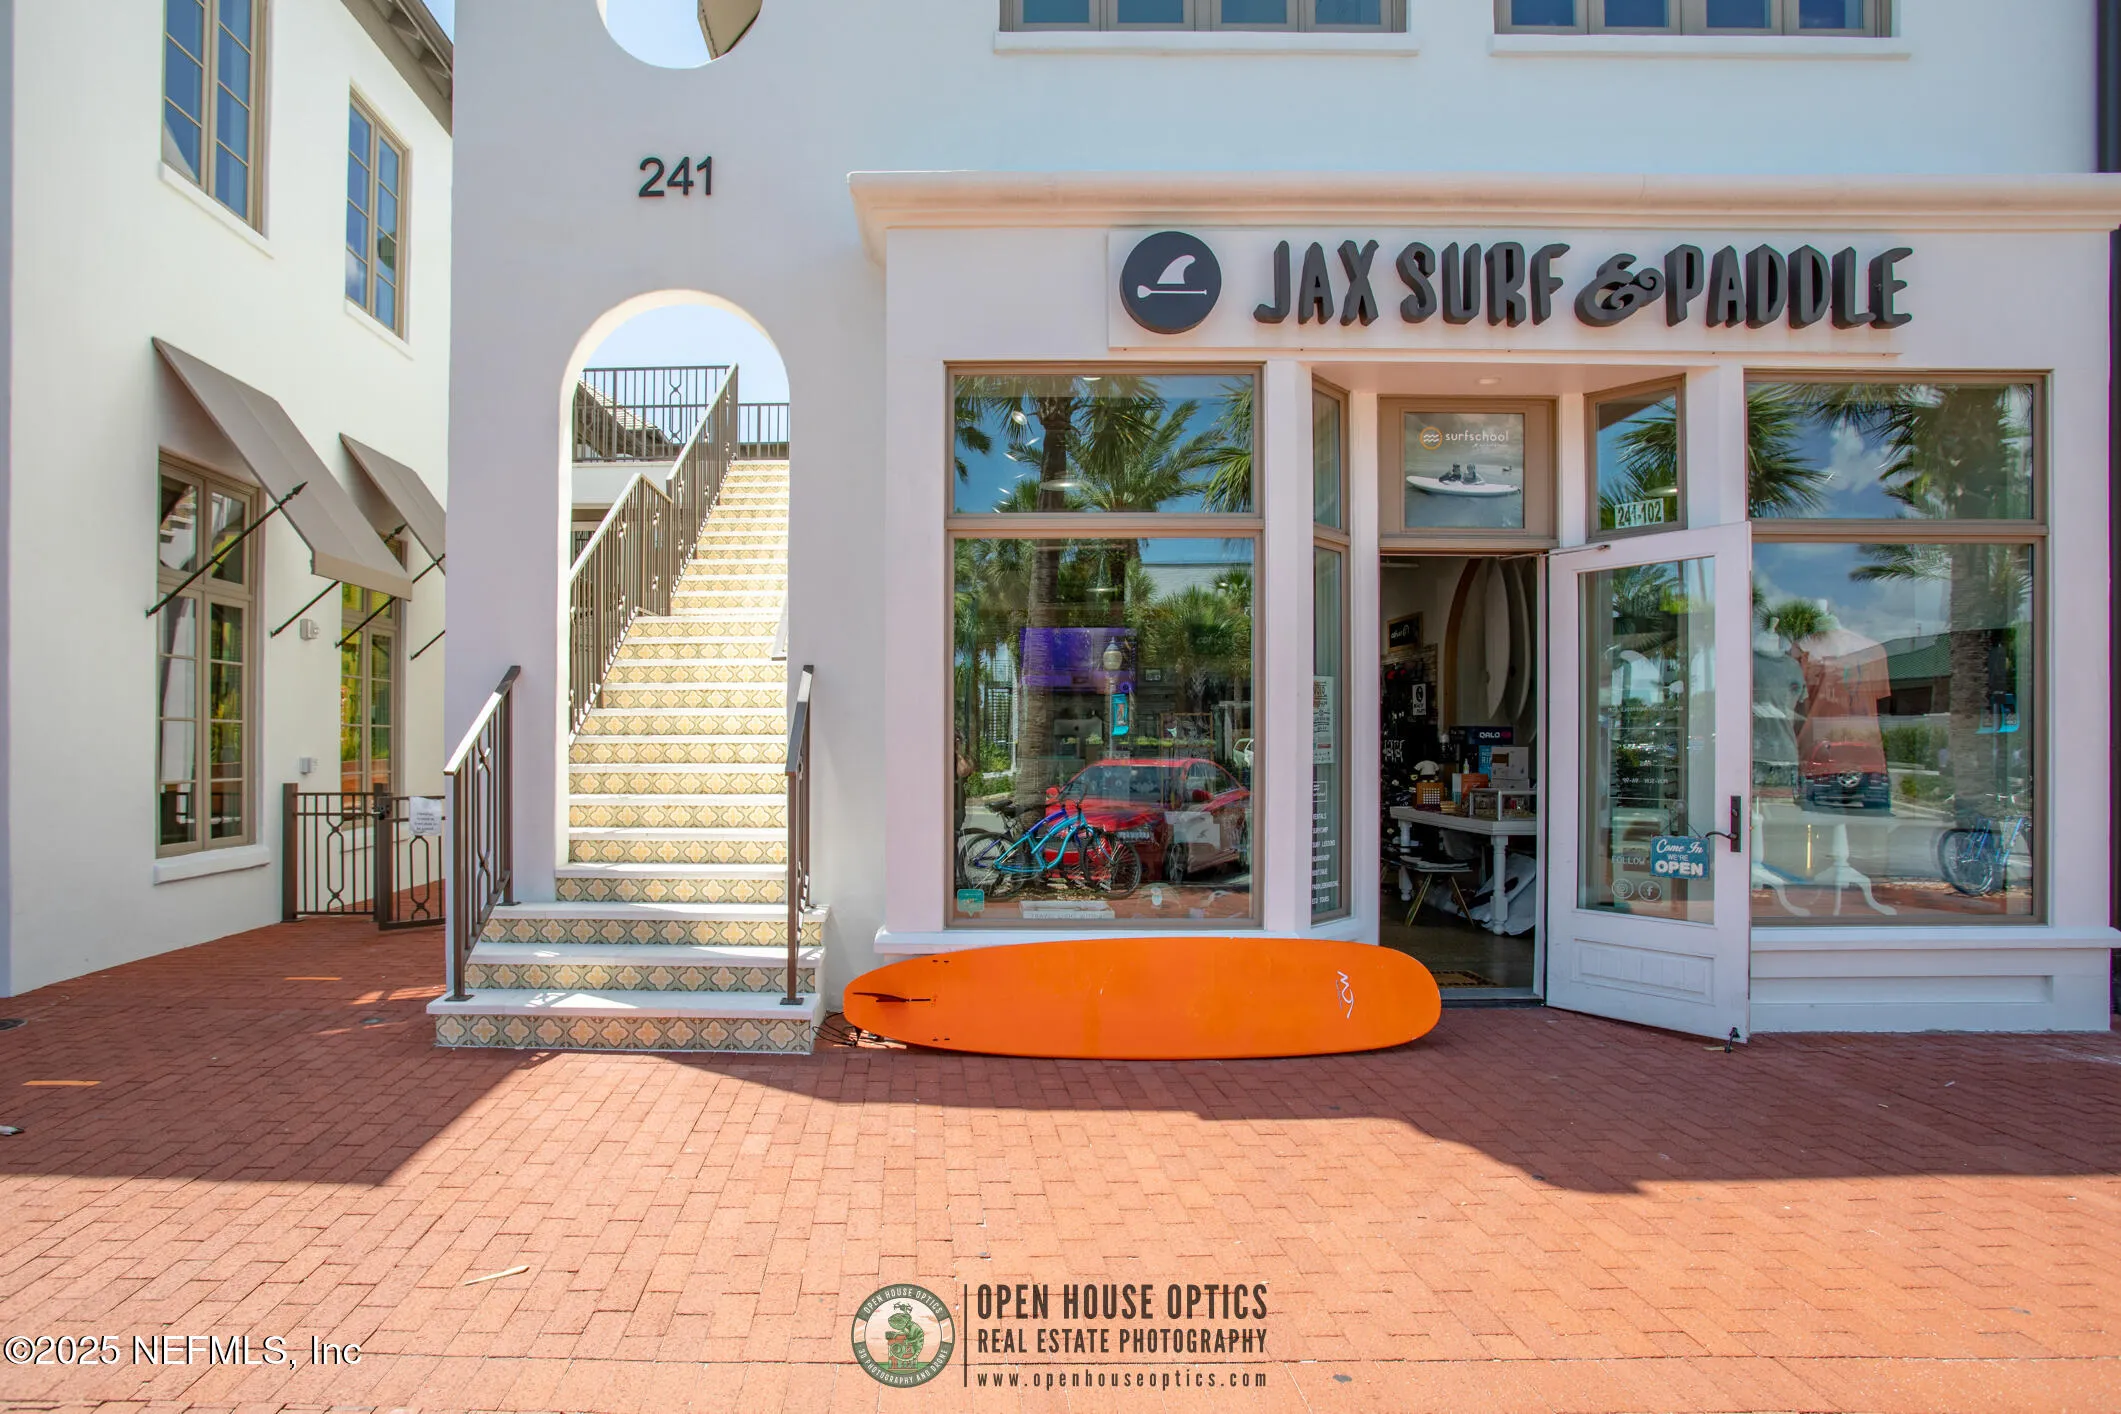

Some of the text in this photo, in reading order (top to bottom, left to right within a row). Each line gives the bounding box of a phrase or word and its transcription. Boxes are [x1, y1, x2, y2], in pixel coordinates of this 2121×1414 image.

[638, 155, 712, 197] 241
[1253, 239, 1914, 330] JAX SURF & PADDLE
[1445, 429, 1509, 442] surfschool
[1617, 501, 1662, 526] 241-102
[1479, 731, 1501, 739] QALO
[1656, 839, 1704, 854] Come In
[1612, 855, 1646, 866] FOLLOW
[1667, 854, 1689, 862] WE'RE
[1655, 860, 1704, 877] OPEN
